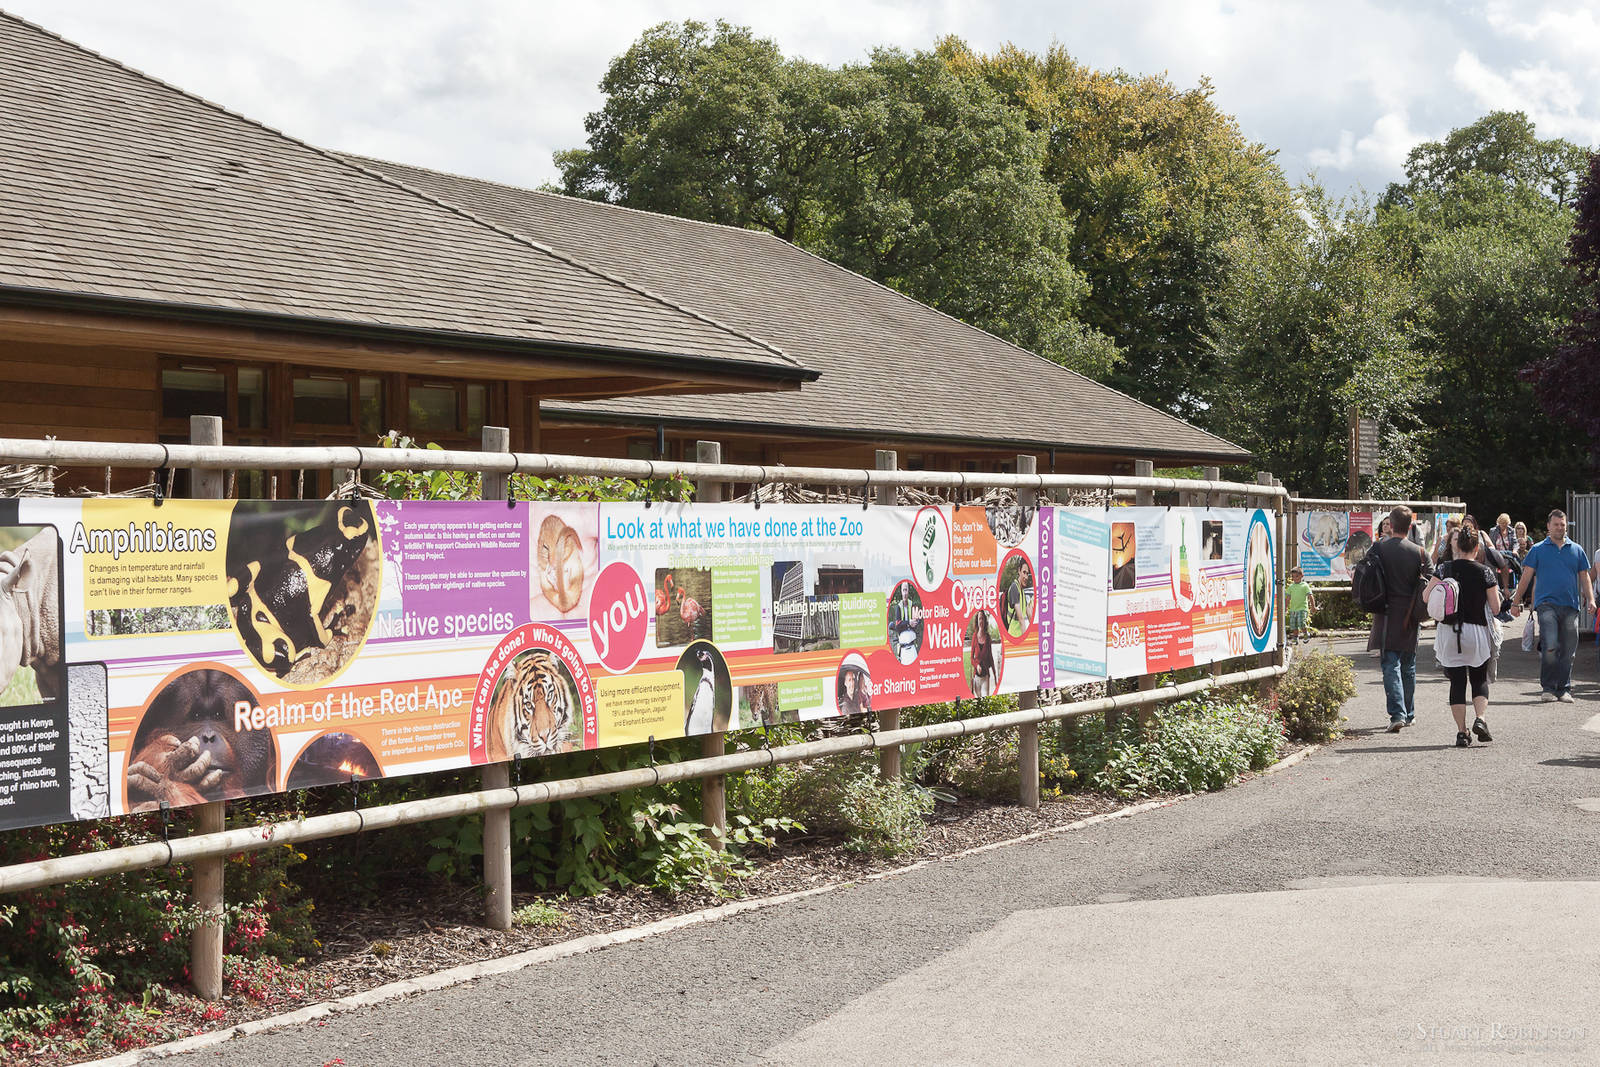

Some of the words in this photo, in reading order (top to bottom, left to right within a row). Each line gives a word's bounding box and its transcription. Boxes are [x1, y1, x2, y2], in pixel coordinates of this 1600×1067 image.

[404, 521, 417, 530] Each
[512, 521, 522, 529] and
[607, 516, 645, 539] Look
[650, 517, 663, 538] at
[667, 517, 702, 538] what
[705, 523, 725, 538] we
[729, 517, 760, 537] have
[764, 517, 798, 537] done
[801, 518, 815, 537] at
[816, 517, 837, 537] the
[839, 517, 863, 536] Zoo
[953, 521, 962, 532] So,
[963, 521, 976, 531] don't
[977, 521, 983, 531] be
[70, 521, 216, 560] Amphibians
[953, 534, 961, 544] the
[963, 533, 973, 544] odd
[1041, 515, 1050, 559] You
[404, 552, 425, 561] Training
[953, 548, 963, 556] one
[89, 564, 119, 574] Changes
[120, 563, 127, 572] in
[128, 563, 168, 573] temperature
[169, 562, 182, 570] and
[183, 562, 205, 570] rainfall
[954, 558, 970, 568] Follow
[970, 560, 980, 568] our
[89, 577, 95, 585] is
[97, 576, 130, 586] damaging
[132, 575, 145, 583] vital
[176, 574, 193, 584] Many
[194, 573, 218, 583] species
[1199, 568, 1228, 609] Save
[90, 588, 108, 597] can't
[109, 588, 121, 596] live
[122, 587, 128, 595] in
[129, 587, 145, 595] their
[146, 586, 169, 594] former
[951, 577, 997, 619] Cycle
[1041, 567, 1050, 612] Can
[773, 600, 808, 616] Building
[809, 598, 840, 616] greener
[842, 597, 878, 613] buildings
[912, 606, 933, 620] Motor
[933, 605, 950, 619] Bike
[378, 611, 439, 639] Native
[444, 607, 514, 640] species
[592, 583, 645, 659] you
[532, 628, 554, 645] Who
[555, 635, 563, 649] is
[927, 622, 963, 650] Walk
[1112, 622, 1140, 649] Save
[1226, 623, 1244, 656] You
[499, 631, 525, 661] done?
[1041, 621, 1051, 683] Help!
[486, 660, 500, 679] be
[561, 645, 584, 679] going
[479, 677, 491, 705] can
[581, 675, 589, 694] to
[600, 688, 616, 698] Using
[617, 687, 630, 695] more
[631, 685, 652, 695] efficient
[867, 681, 882, 696] Car
[884, 678, 916, 695] Sharing
[234, 698, 306, 732] Realm
[311, 693, 334, 722] of
[340, 691, 375, 719] the
[380, 686, 419, 715] Red
[423, 683, 463, 716] Ape
[585, 696, 594, 714] do
[651, 695, 667, 705] savings
[652, 705, 668, 714] Jaguar
[22, 719, 29, 729] in
[30, 718, 54, 729] Kenya
[473, 706, 484, 749] What
[586, 716, 596, 735] it?
[623, 717, 641, 728] Elephant
[642, 715, 665, 724] Enclosures
[6, 733, 14, 743] in
[15, 731, 33, 742] local
[34, 729, 60, 741] people
[11, 744, 28, 755] 80%
[28, 743, 37, 753] of
[38, 741, 56, 752] their
[22, 766, 56, 778] including
[10, 782, 18, 792] of
[20, 781, 39, 791] rhino
[40, 779, 60, 789] horn,
